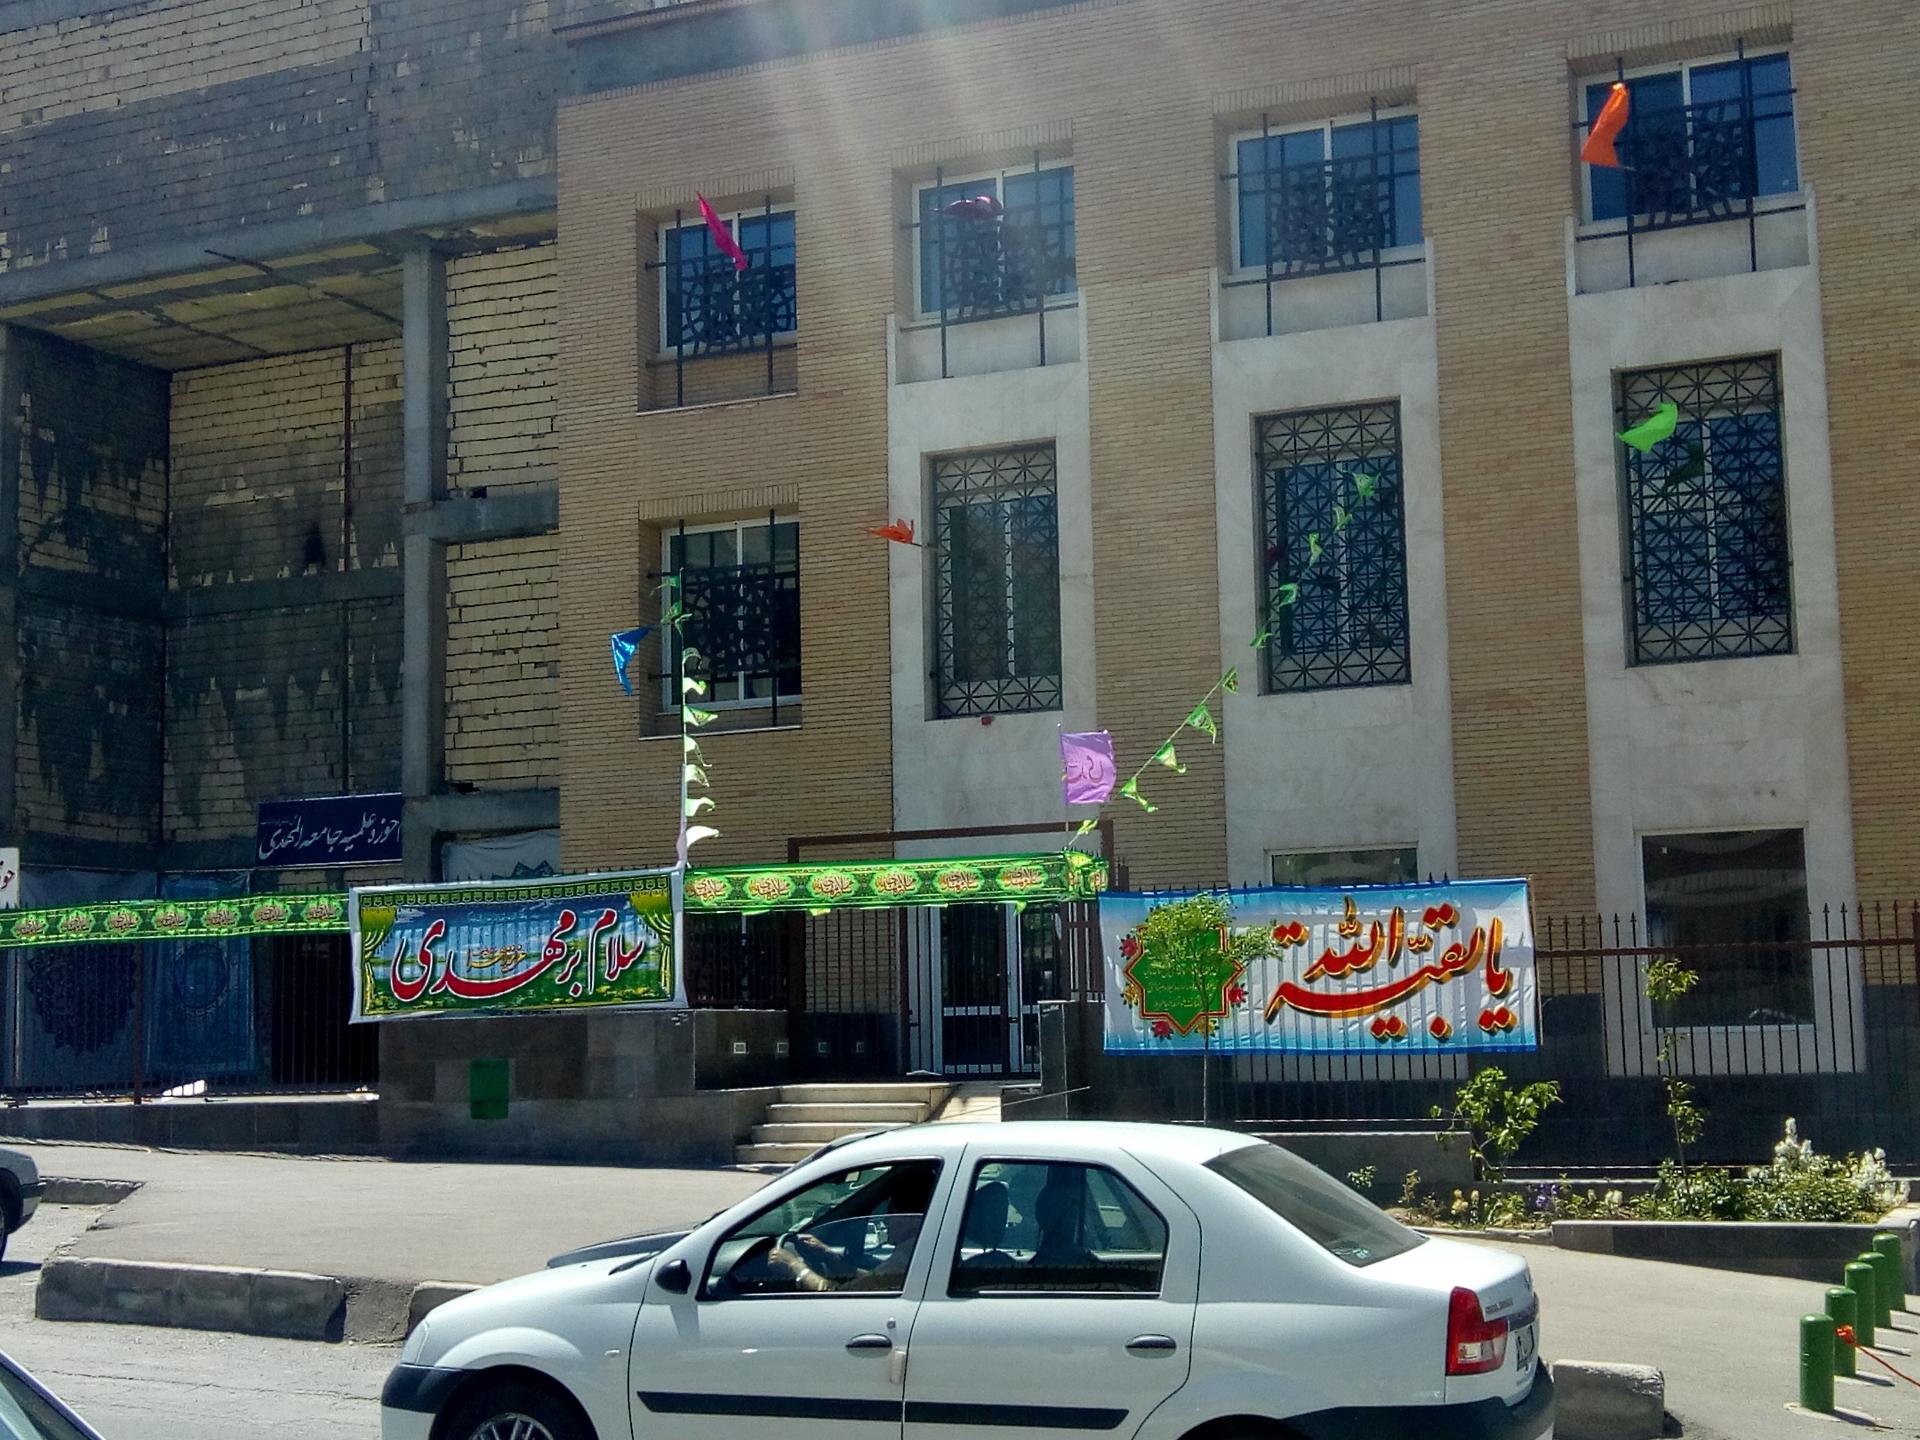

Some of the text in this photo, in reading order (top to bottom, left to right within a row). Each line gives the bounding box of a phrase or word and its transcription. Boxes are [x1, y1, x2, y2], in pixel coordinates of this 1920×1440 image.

[390, 907, 645, 1002] سلام بر مهدی
[1477, 916, 1517, 1034] یا
